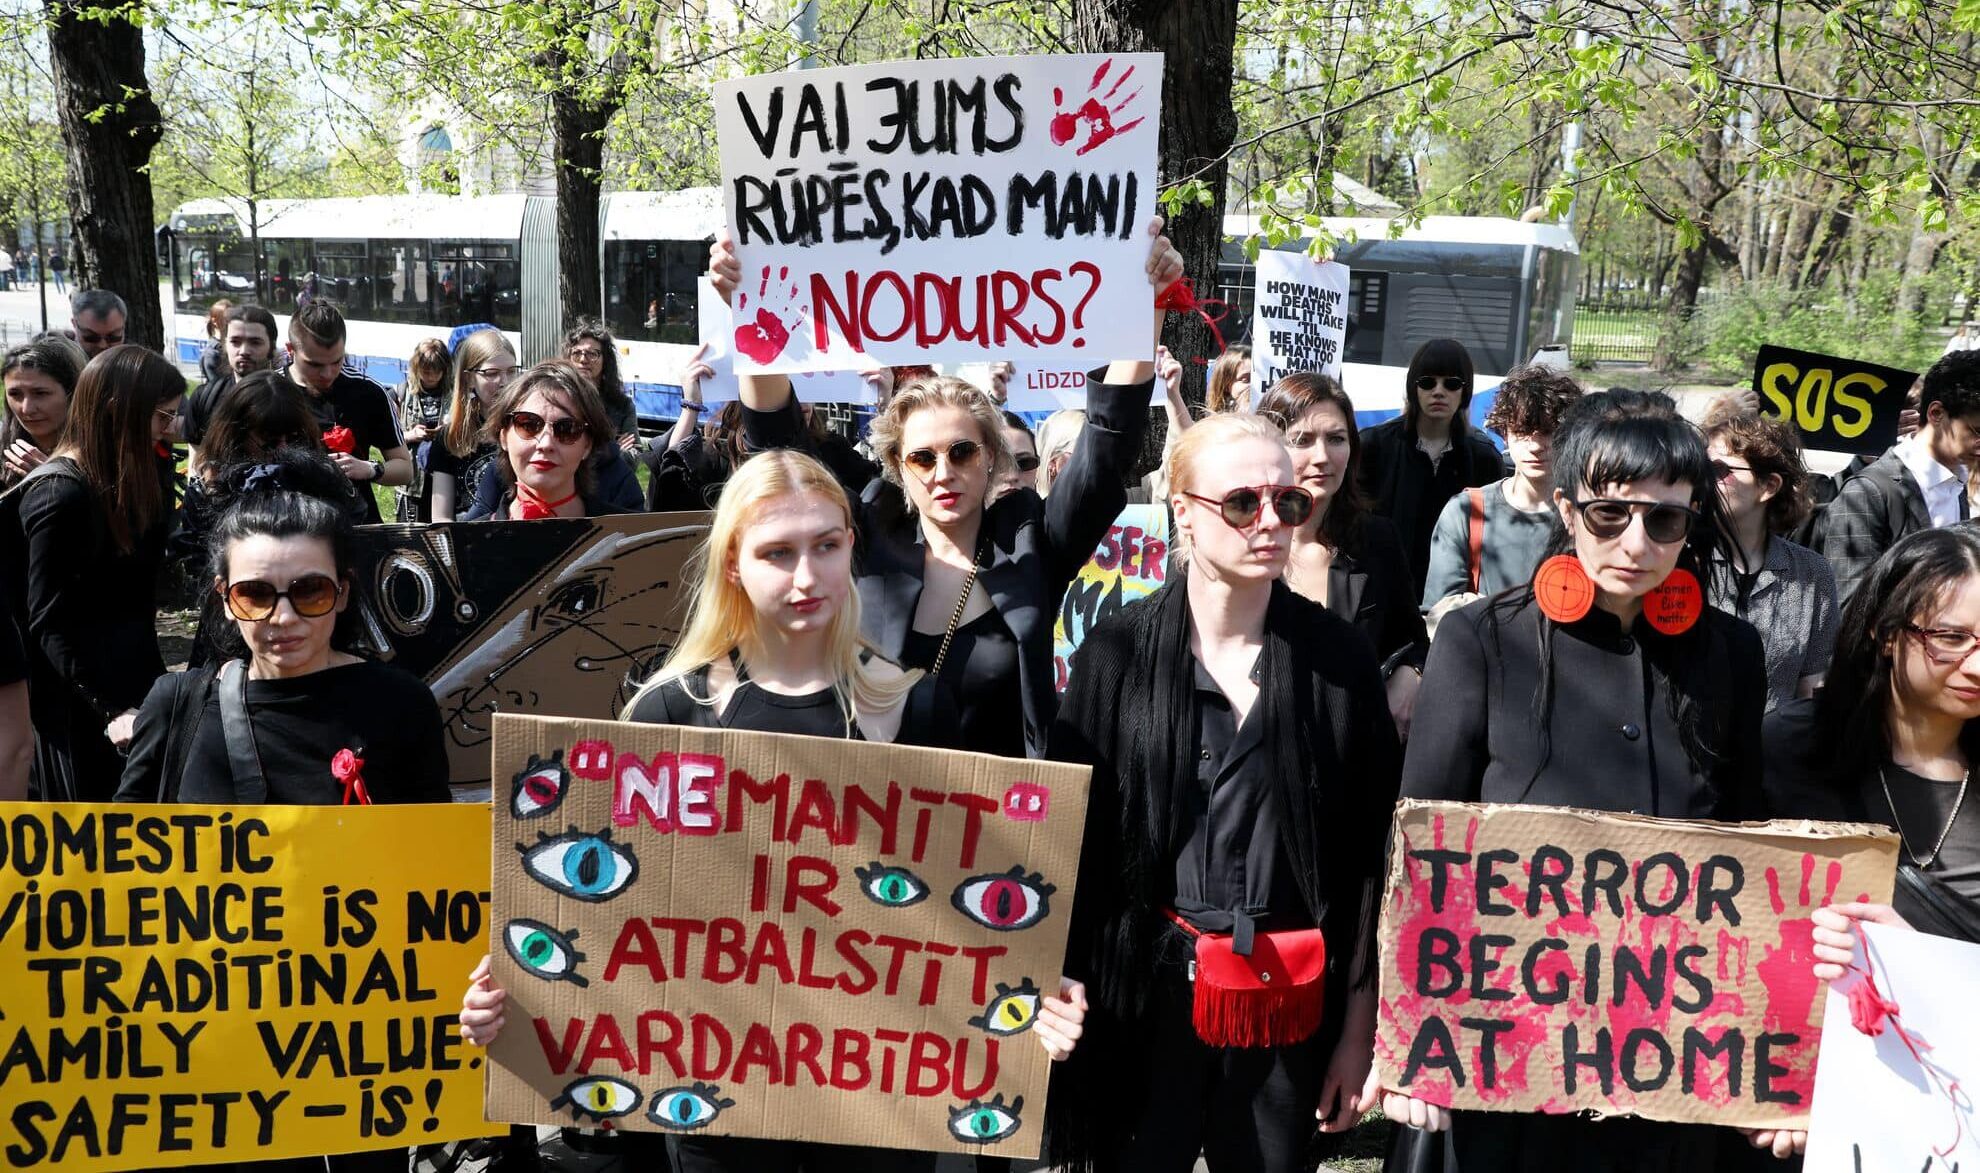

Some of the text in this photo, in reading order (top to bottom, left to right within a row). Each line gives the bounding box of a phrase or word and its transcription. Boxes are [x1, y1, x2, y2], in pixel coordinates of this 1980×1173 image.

[736, 72, 1026, 159] VAI JUMS
[1006, 169, 1138, 240] MANI
[810, 261, 1103, 354] NODURS?
[1260, 305, 1343, 329] WILL IT TAKE
[1267, 281, 1341, 304] HOW MANY
[1281, 295, 1332, 314] DEATHS
[1269, 331, 1337, 352] HE KNOWS
[1271, 343, 1333, 363] THAT TOO
[1287, 356, 1324, 372] MANY
[1760, 362, 1888, 438] SOS
[1084, 525, 1168, 582] SER
[0, 811, 274, 877] OMESTiC
[751, 855, 843, 917] IR
[1409, 844, 1746, 927] TERROR
[603, 916, 1008, 1007] ATBALSTĪT
[1416, 927, 1715, 1014] BEGINS
[532, 1010, 1000, 1101] VARDARBĪBU
[1399, 1015, 1803, 1105] AT HOME
